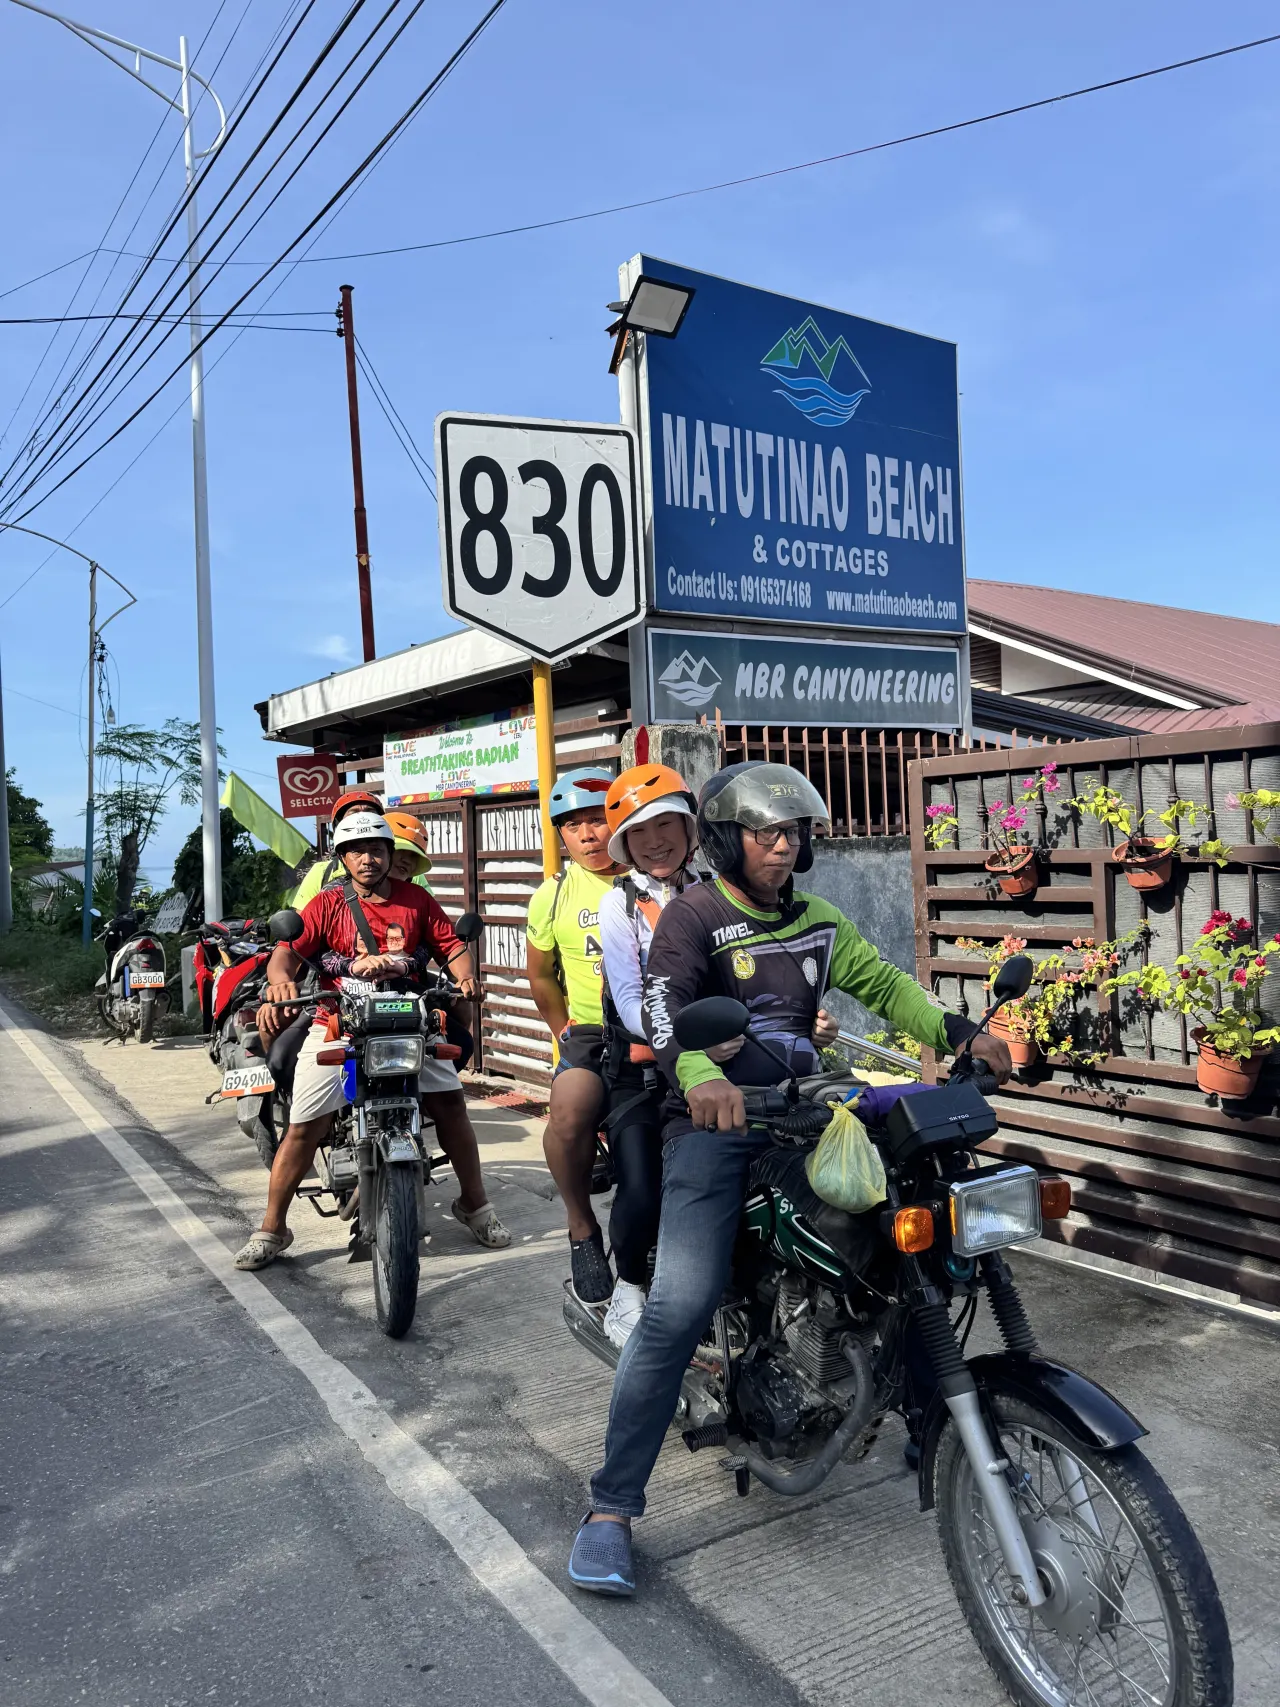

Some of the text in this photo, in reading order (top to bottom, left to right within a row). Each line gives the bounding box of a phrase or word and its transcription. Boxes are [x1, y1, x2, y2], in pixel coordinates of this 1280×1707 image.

[662, 412, 954, 545] MATUTINAO BEACH
[459, 455, 626, 598] 830
[752, 534, 889, 577] & COTTAGES
[667, 566, 958, 620] Contact Us: 09165374168 www.matutinaobeach.com
[734, 662, 955, 705] MBR CANYONEERING
[499, 716, 537, 737] LOVE
[385, 740, 417, 757] LOVE
[400, 741, 520, 777] BREATHTAKING BADIAN
[440, 769, 471, 784] LOVE
[290, 796, 334, 808] SELECTA
